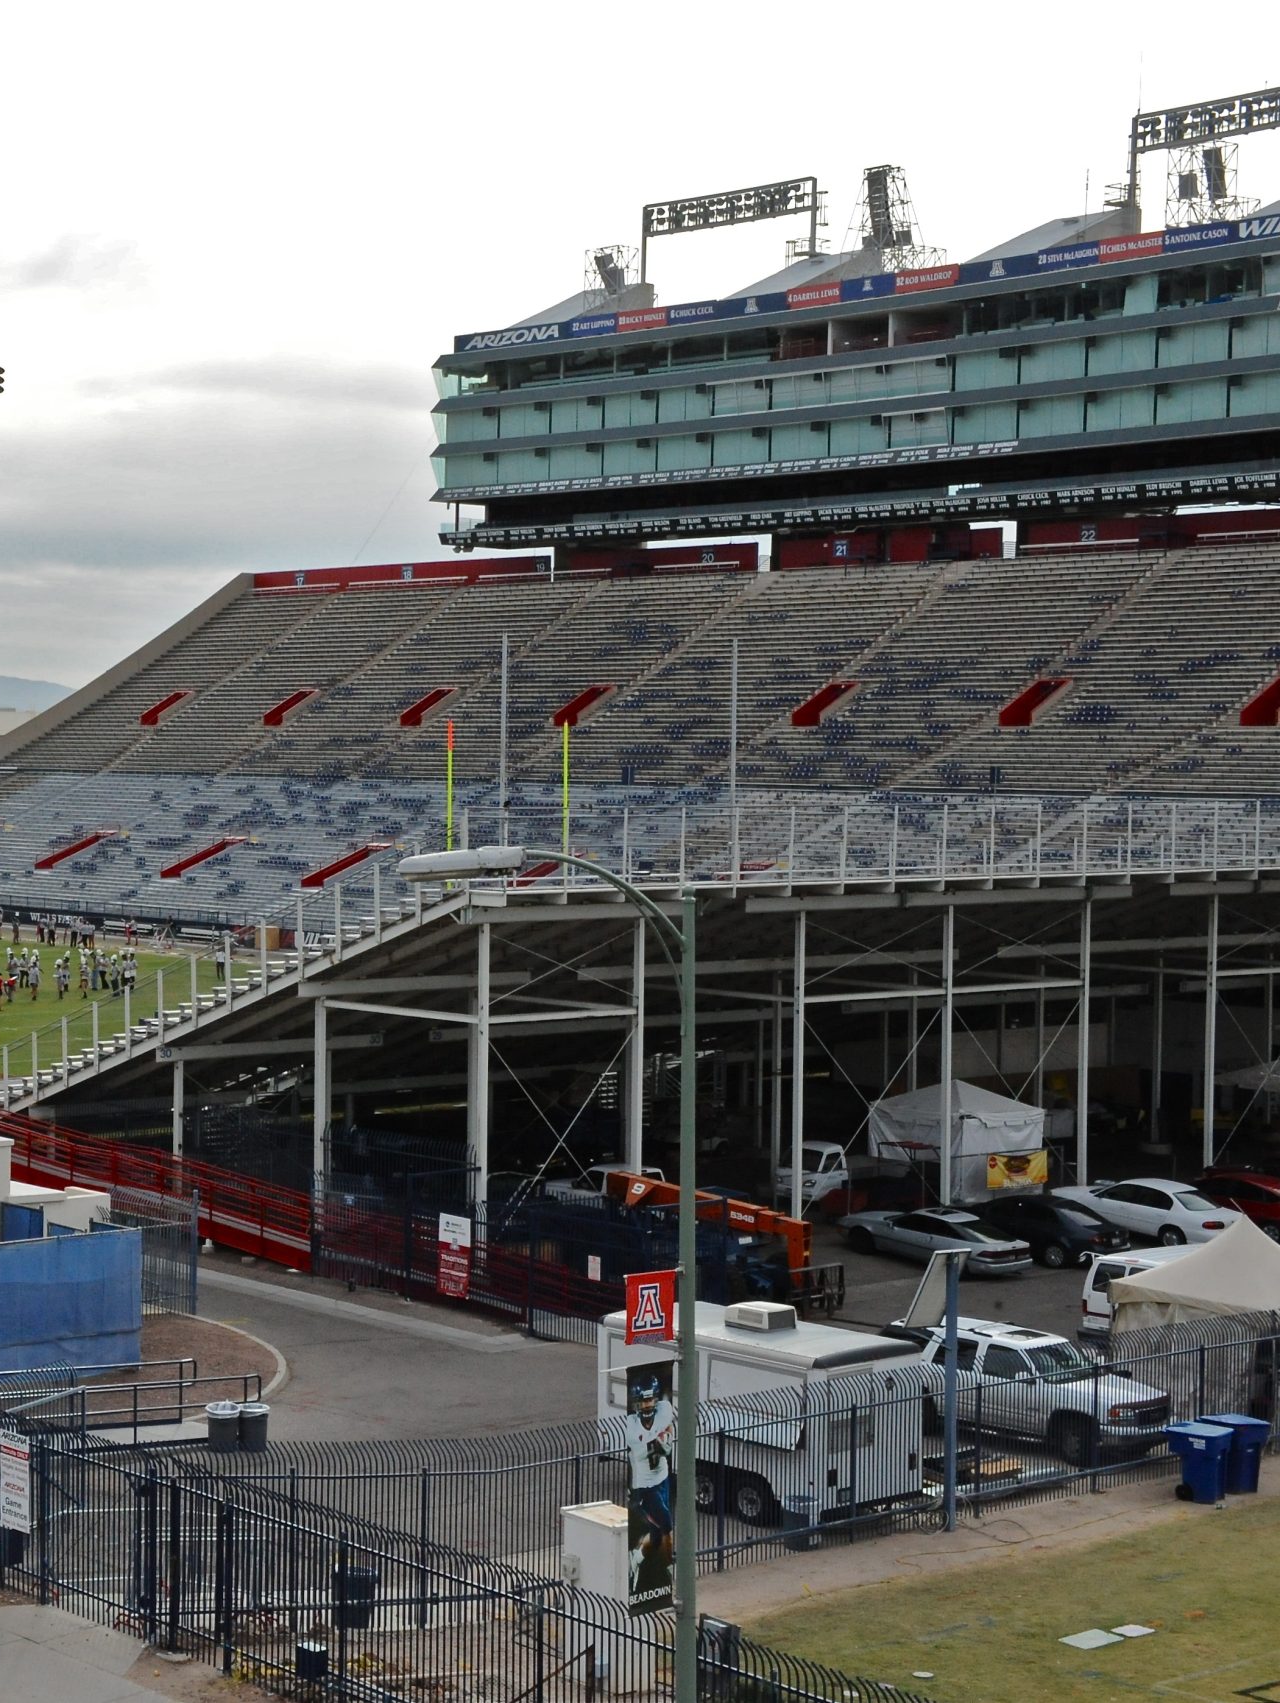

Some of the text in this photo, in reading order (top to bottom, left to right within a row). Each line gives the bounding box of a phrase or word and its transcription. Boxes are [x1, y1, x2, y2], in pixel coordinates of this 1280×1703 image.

[1165, 228, 1228, 245] 5 ANTOINE CASON
[1107, 243, 1127, 254] CHRIS
[1127, 237, 1163, 250] McALISTER
[1048, 252, 1063, 263] STEVE
[1064, 247, 1099, 261] McLAUGHLIN
[905, 275, 919, 285] ROB
[920, 271, 952, 283] WALDROP
[793, 291, 820, 302] DARRYLL
[820, 287, 840, 299] LEWIS
[626, 314, 642, 325] RICKY
[643, 312, 666, 322] HUNLEY
[675, 308, 696, 319] CHUCK
[696, 306, 714, 315] CECIL
[579, 321, 590, 330] ART
[591, 318, 615, 329] LUPPINO
[464, 324, 559, 350] ARIZONA
[1081, 531, 1096, 542] 22
[835, 545, 847, 556] 21
[702, 553, 714, 563] 20
[403, 570, 412, 579] 18
[296, 577, 304, 586] 17
[160, 1047, 172, 1058] 30
[1, 1431, 27, 1446] ARIZONA
[4, 1481, 25, 1493] ARIZONA
[5, 1497, 22, 1510] Game
[2, 1505, 28, 1522] Entrance
[628, 1585, 672, 1606] BEARDOWN
